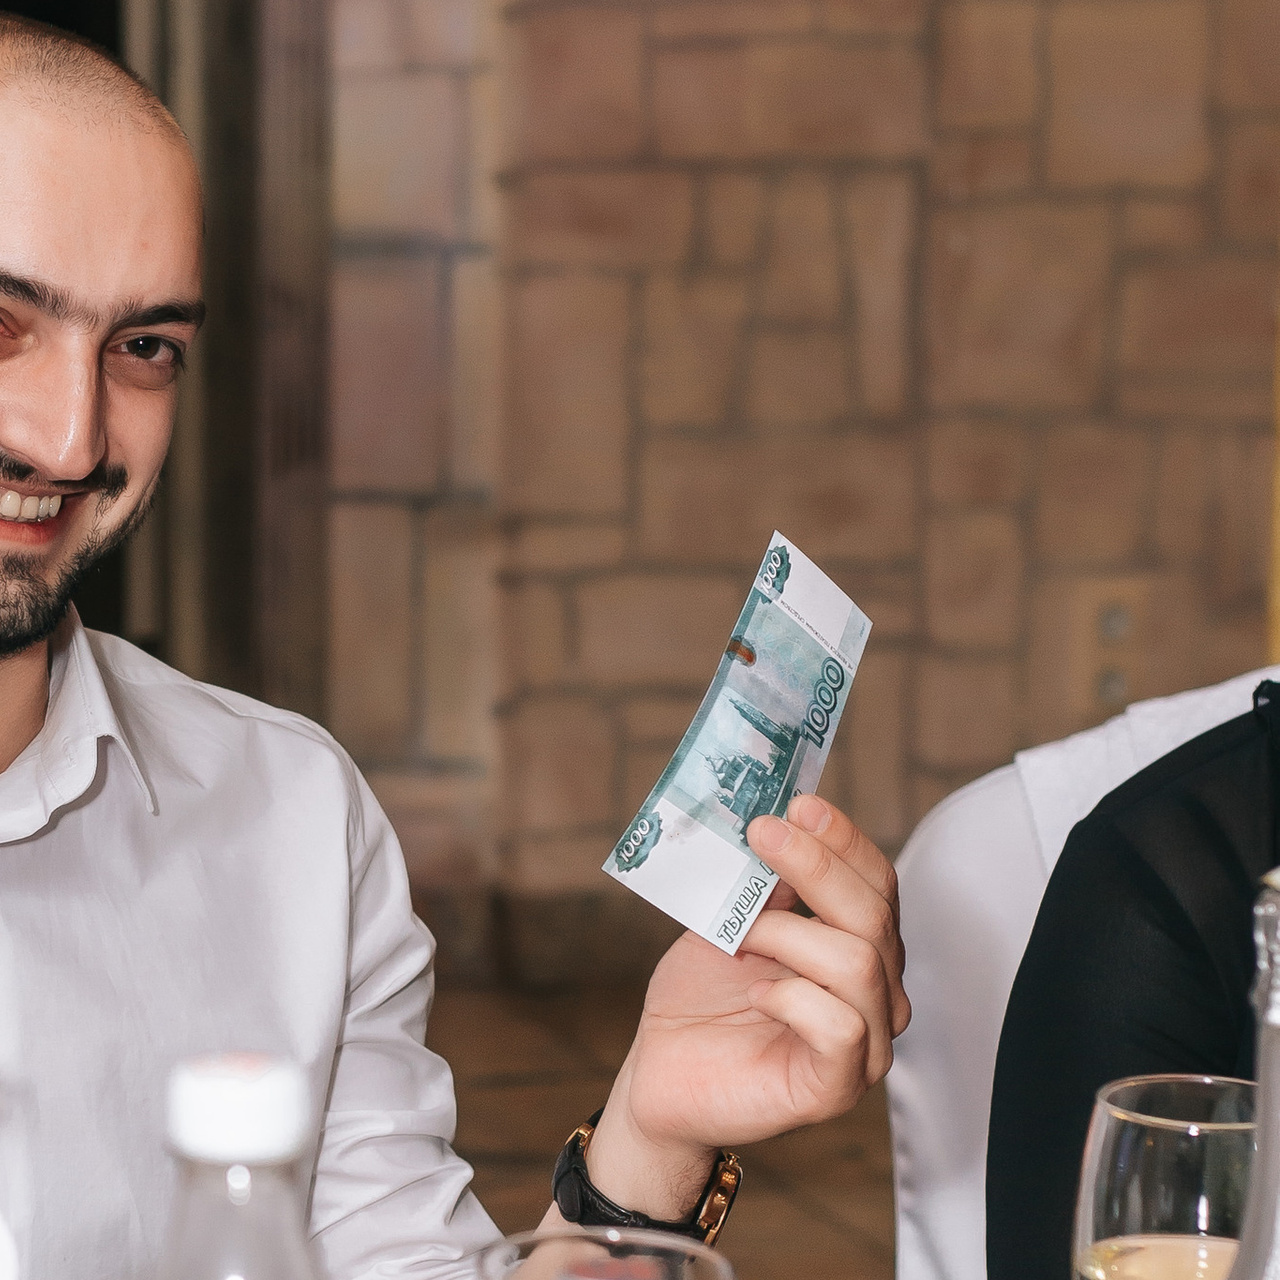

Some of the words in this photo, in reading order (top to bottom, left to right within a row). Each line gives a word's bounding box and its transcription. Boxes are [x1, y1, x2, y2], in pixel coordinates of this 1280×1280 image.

[759, 551, 782, 595] 1000
[800, 656, 845, 750] 1000
[619, 817, 651, 863] 1000
